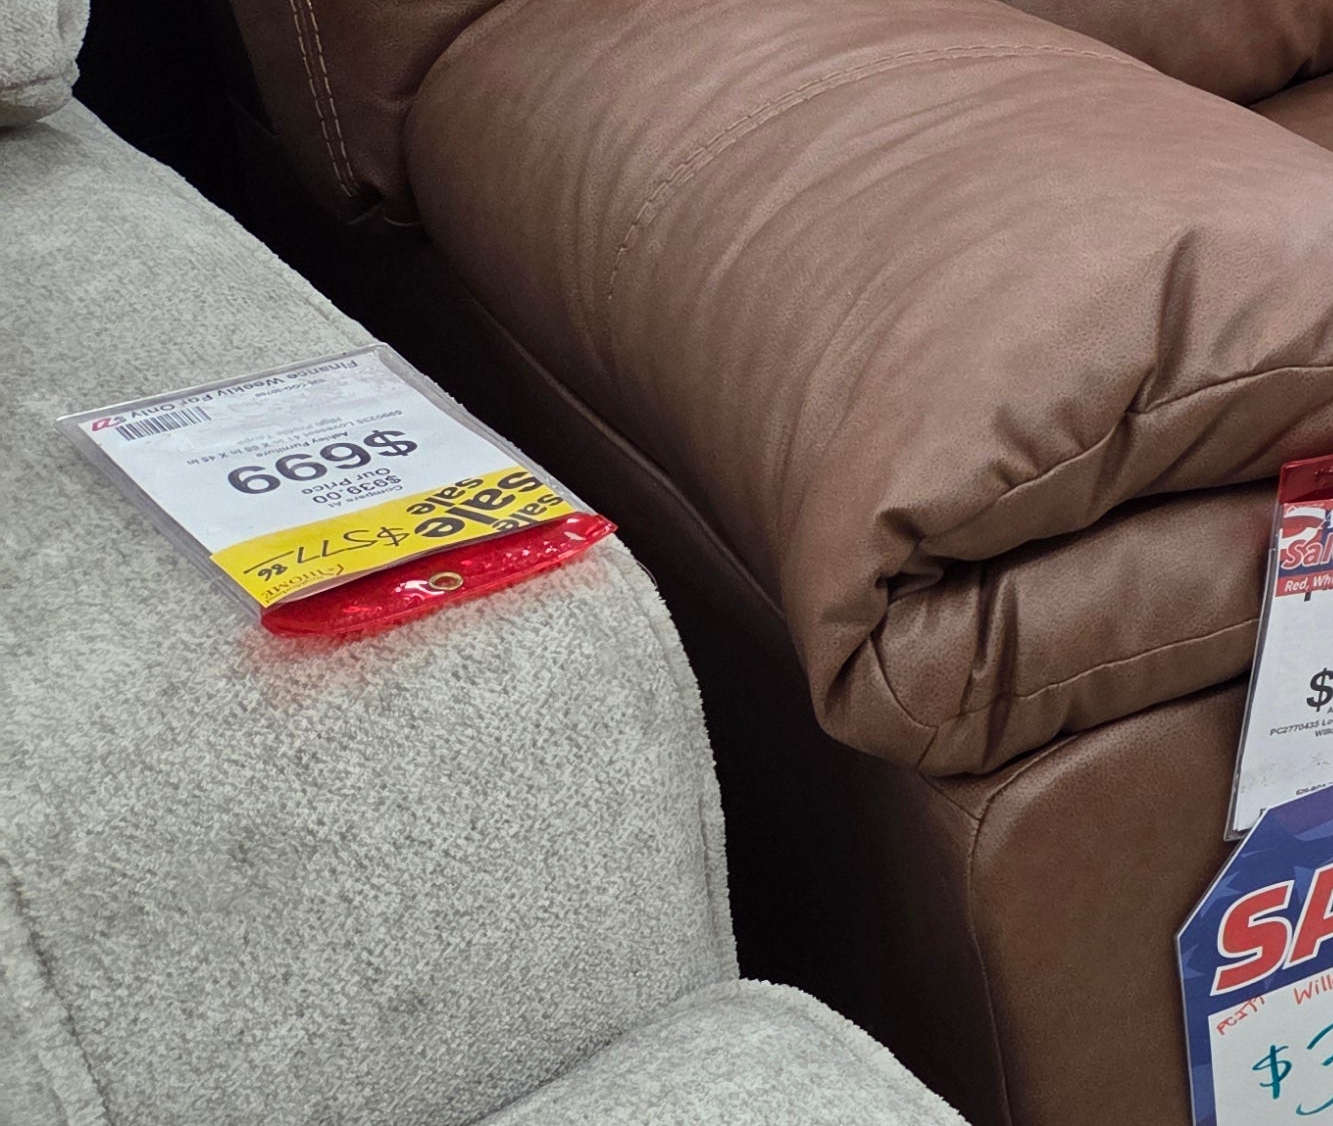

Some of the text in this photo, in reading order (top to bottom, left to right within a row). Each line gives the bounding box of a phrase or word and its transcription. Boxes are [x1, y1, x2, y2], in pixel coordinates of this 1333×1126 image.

[285, 359, 359, 381] Finance
[179, 392, 214, 405] For
[216, 377, 286, 398] Weekly
[130, 401, 176, 419] Only
[255, 431, 350, 458] Ashley Furniture
[227, 429, 418, 494] $699
[300, 467, 391, 495] Our Price
[312, 474, 402, 505] $939.00
[405, 477, 484, 516] sale
[414, 470, 545, 538] sale
[296, 526, 411, 566] $577
[1284, 579, 1309, 592] Red,
